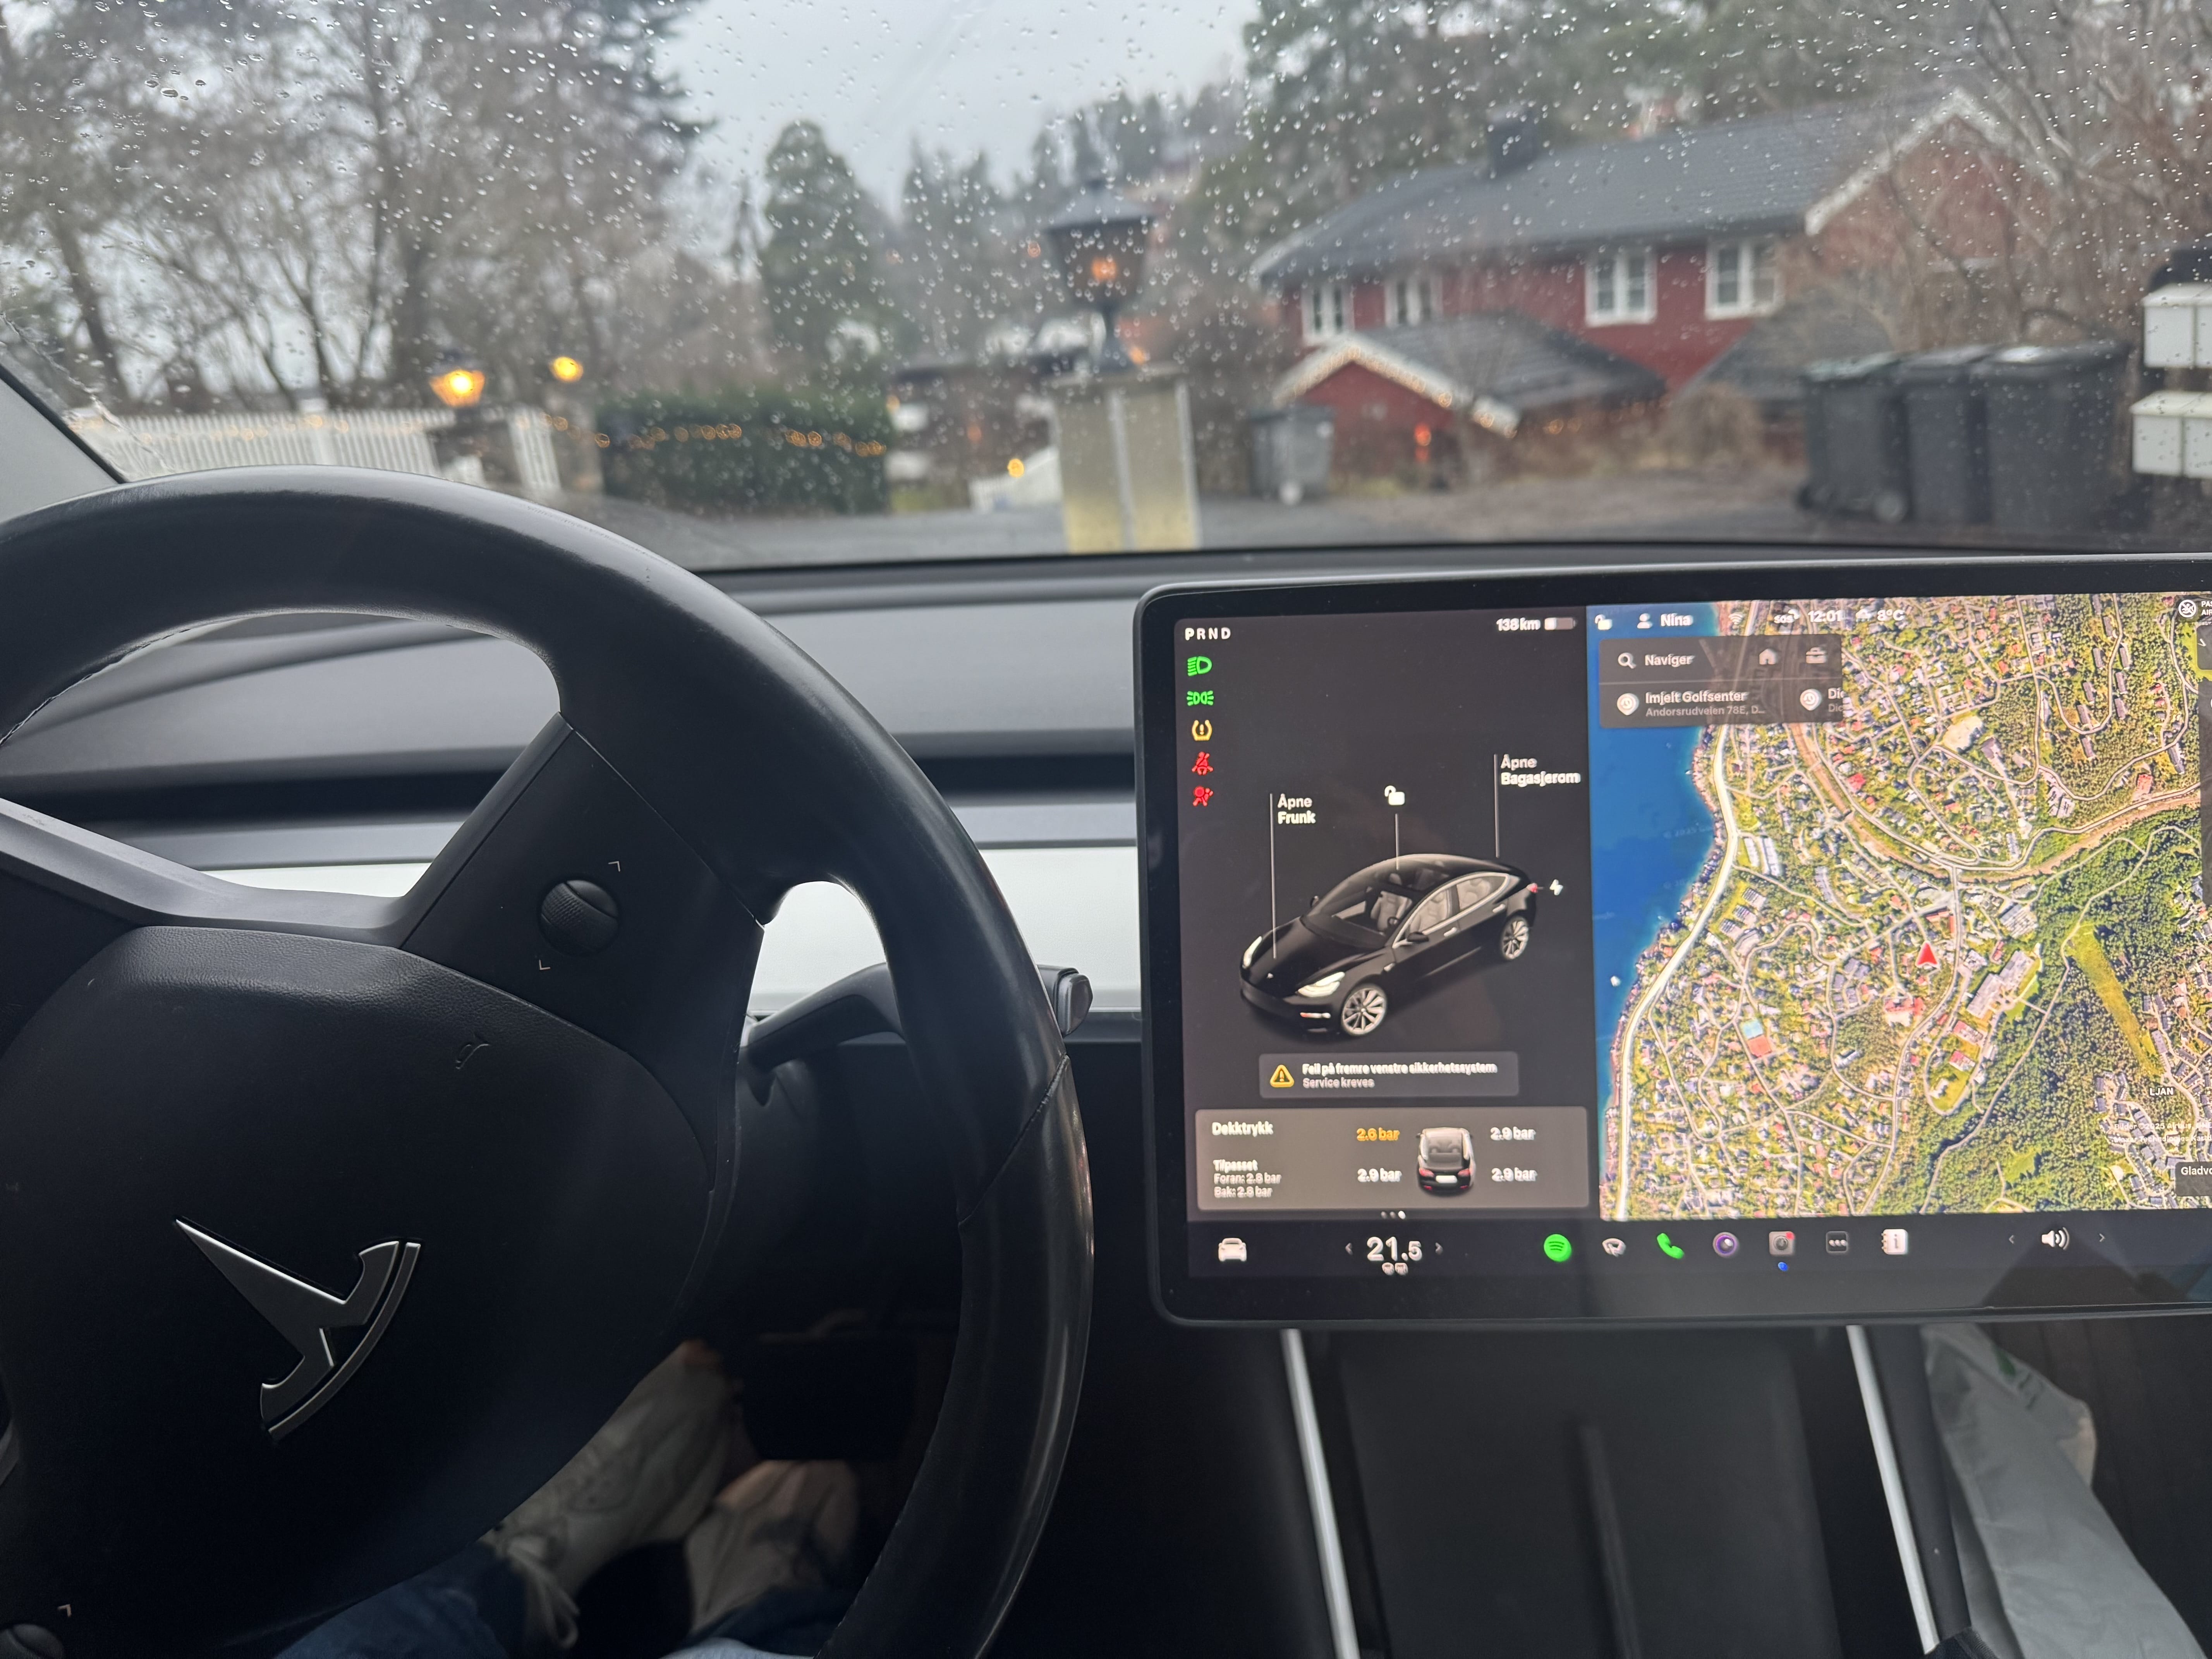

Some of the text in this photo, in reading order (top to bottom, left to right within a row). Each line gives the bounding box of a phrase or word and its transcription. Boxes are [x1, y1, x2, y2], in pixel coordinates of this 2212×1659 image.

[1661, 613, 1693, 627] Nina
[1808, 610, 1842, 622] 12:01
[1645, 653, 1696, 667] Naviger
[1682, 690, 1749, 702] Golfsenter
[1646, 706, 1724, 716] Andorsrudveien
[1501, 771, 1581, 787] Bagasjerom
[1278, 810, 1316, 824] Frunk
[1302, 1062, 1498, 1077] Feil på fremre venstre sikkerhetssystem
[1303, 1077, 1375, 1089] Service kreves
[1212, 1121, 1274, 1137] Dekktrykk
[1357, 1127, 1400, 1141] 2.6 bar
[1491, 1126, 1536, 1140] 2.9 bar
[1214, 1173, 1245, 1185] Foran:
[1264, 1172, 1282, 1184] bar
[1357, 1168, 1402, 1182] 2.9 bar
[1492, 1167, 1538, 1182] 2.9 bar
[1214, 1186, 1236, 1198] Bak:
[1255, 1185, 1273, 1197] bar
[1367, 1237, 1422, 1261] 21.5
